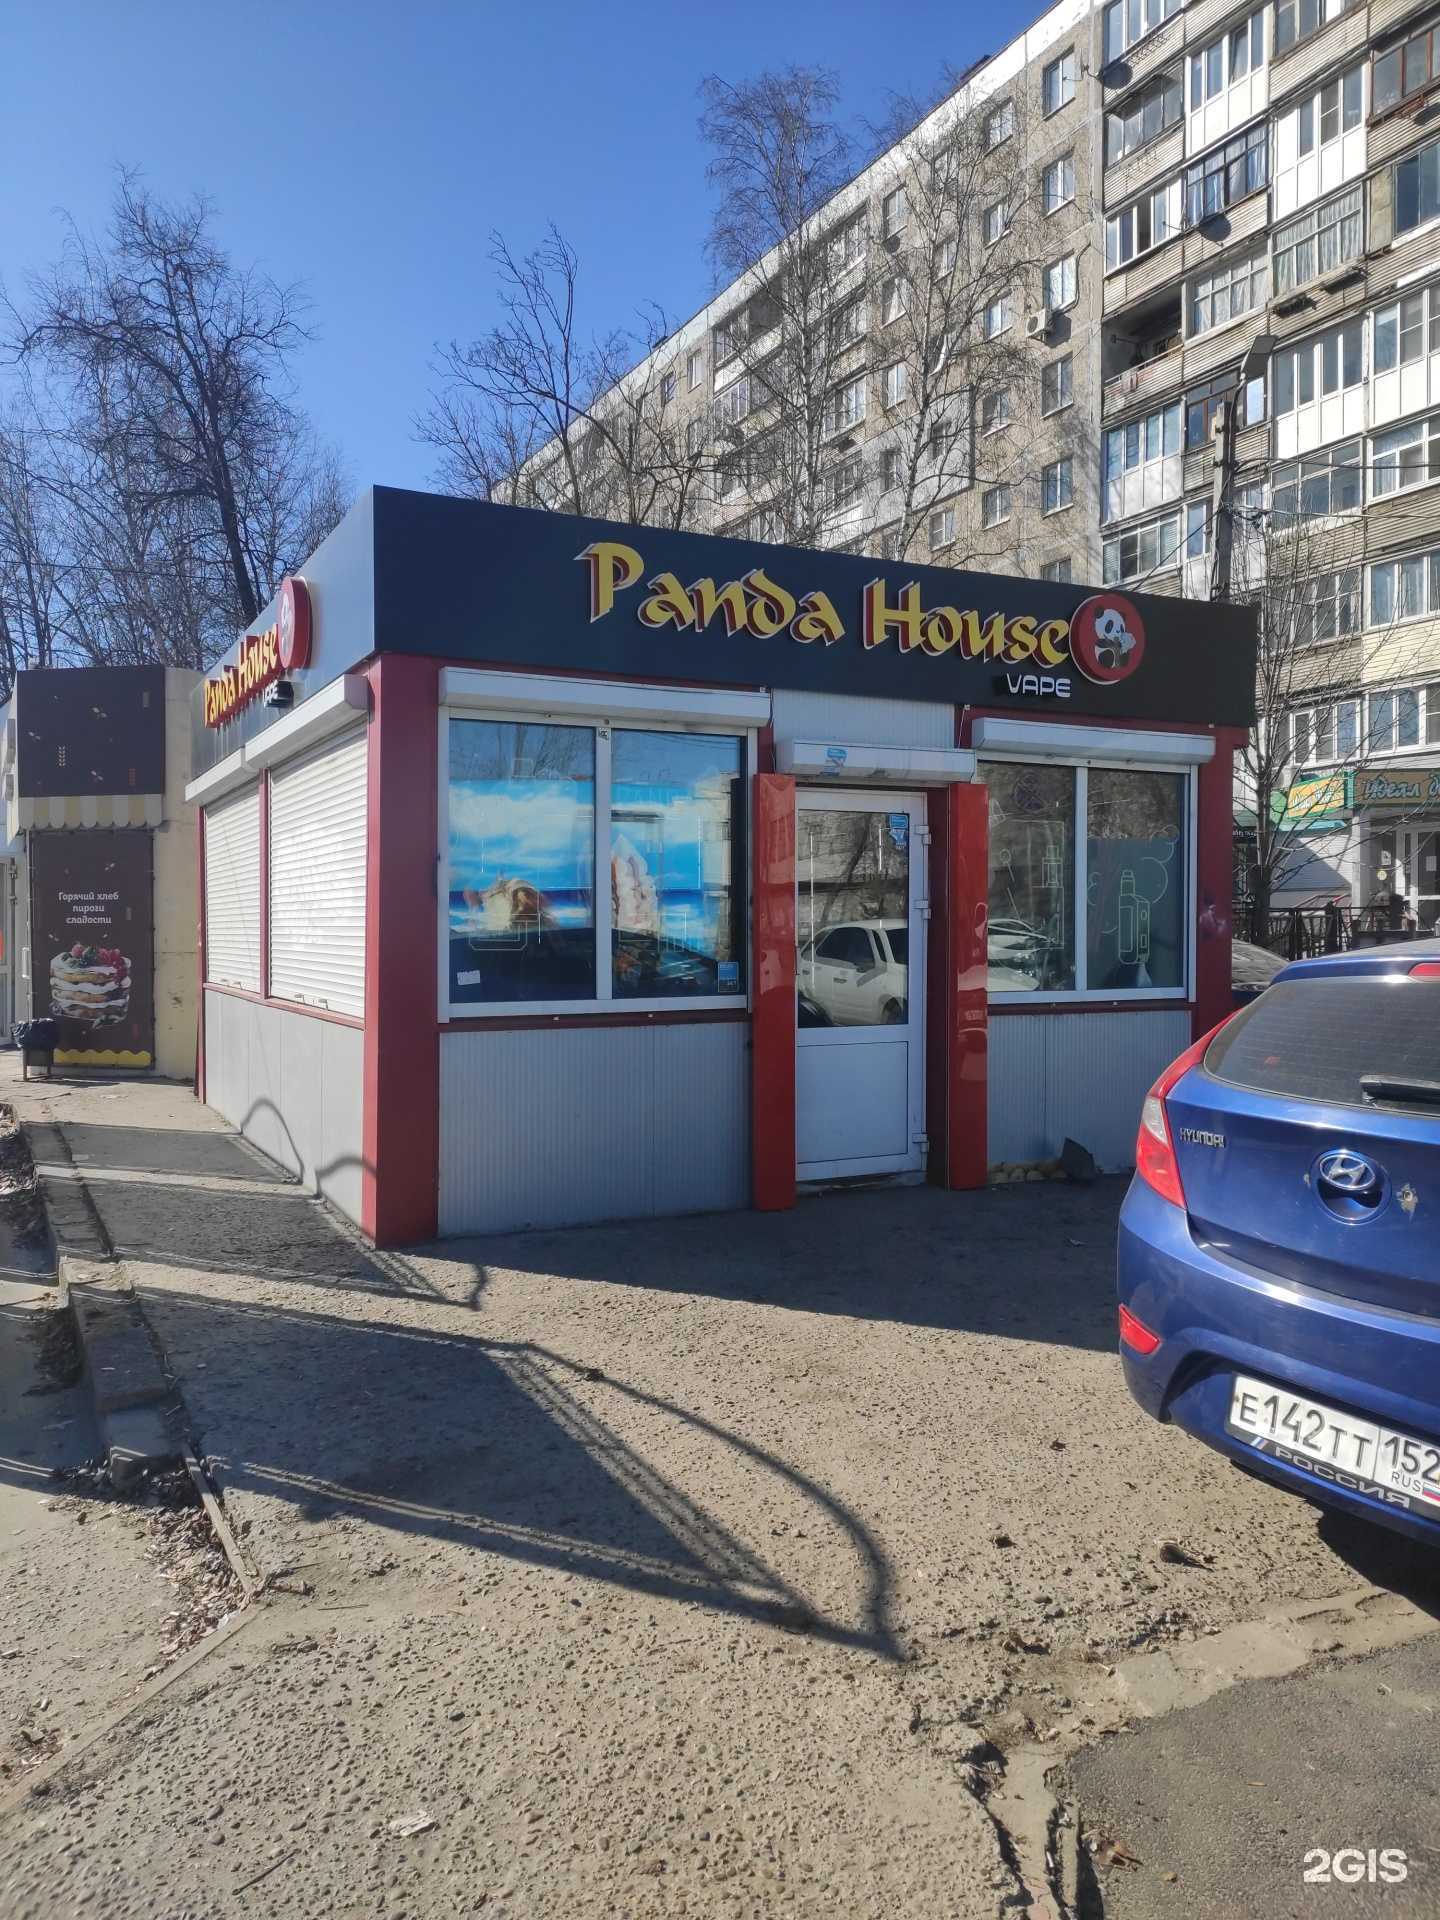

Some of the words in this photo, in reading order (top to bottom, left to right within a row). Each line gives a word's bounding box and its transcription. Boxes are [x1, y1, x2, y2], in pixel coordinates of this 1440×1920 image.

[574, 542, 846, 646] Panda
[863, 577, 1070, 669] House
[204, 666, 236, 729] Panda
[238, 623, 278, 699] House
[1006, 673, 1072, 698] VAPE
[58, 891, 95, 903] Горячий
[96, 891, 119, 901] хлеб
[65, 915, 112, 924] сладости
[72, 905, 105, 914] пироги
[1179, 1127, 1225, 1149] HYUNDAI
[1384, 1436, 1440, 1484] 152
[1275, 1446, 1411, 1509] РОССИЯ
[1391, 1471, 1422, 1493] RUS
